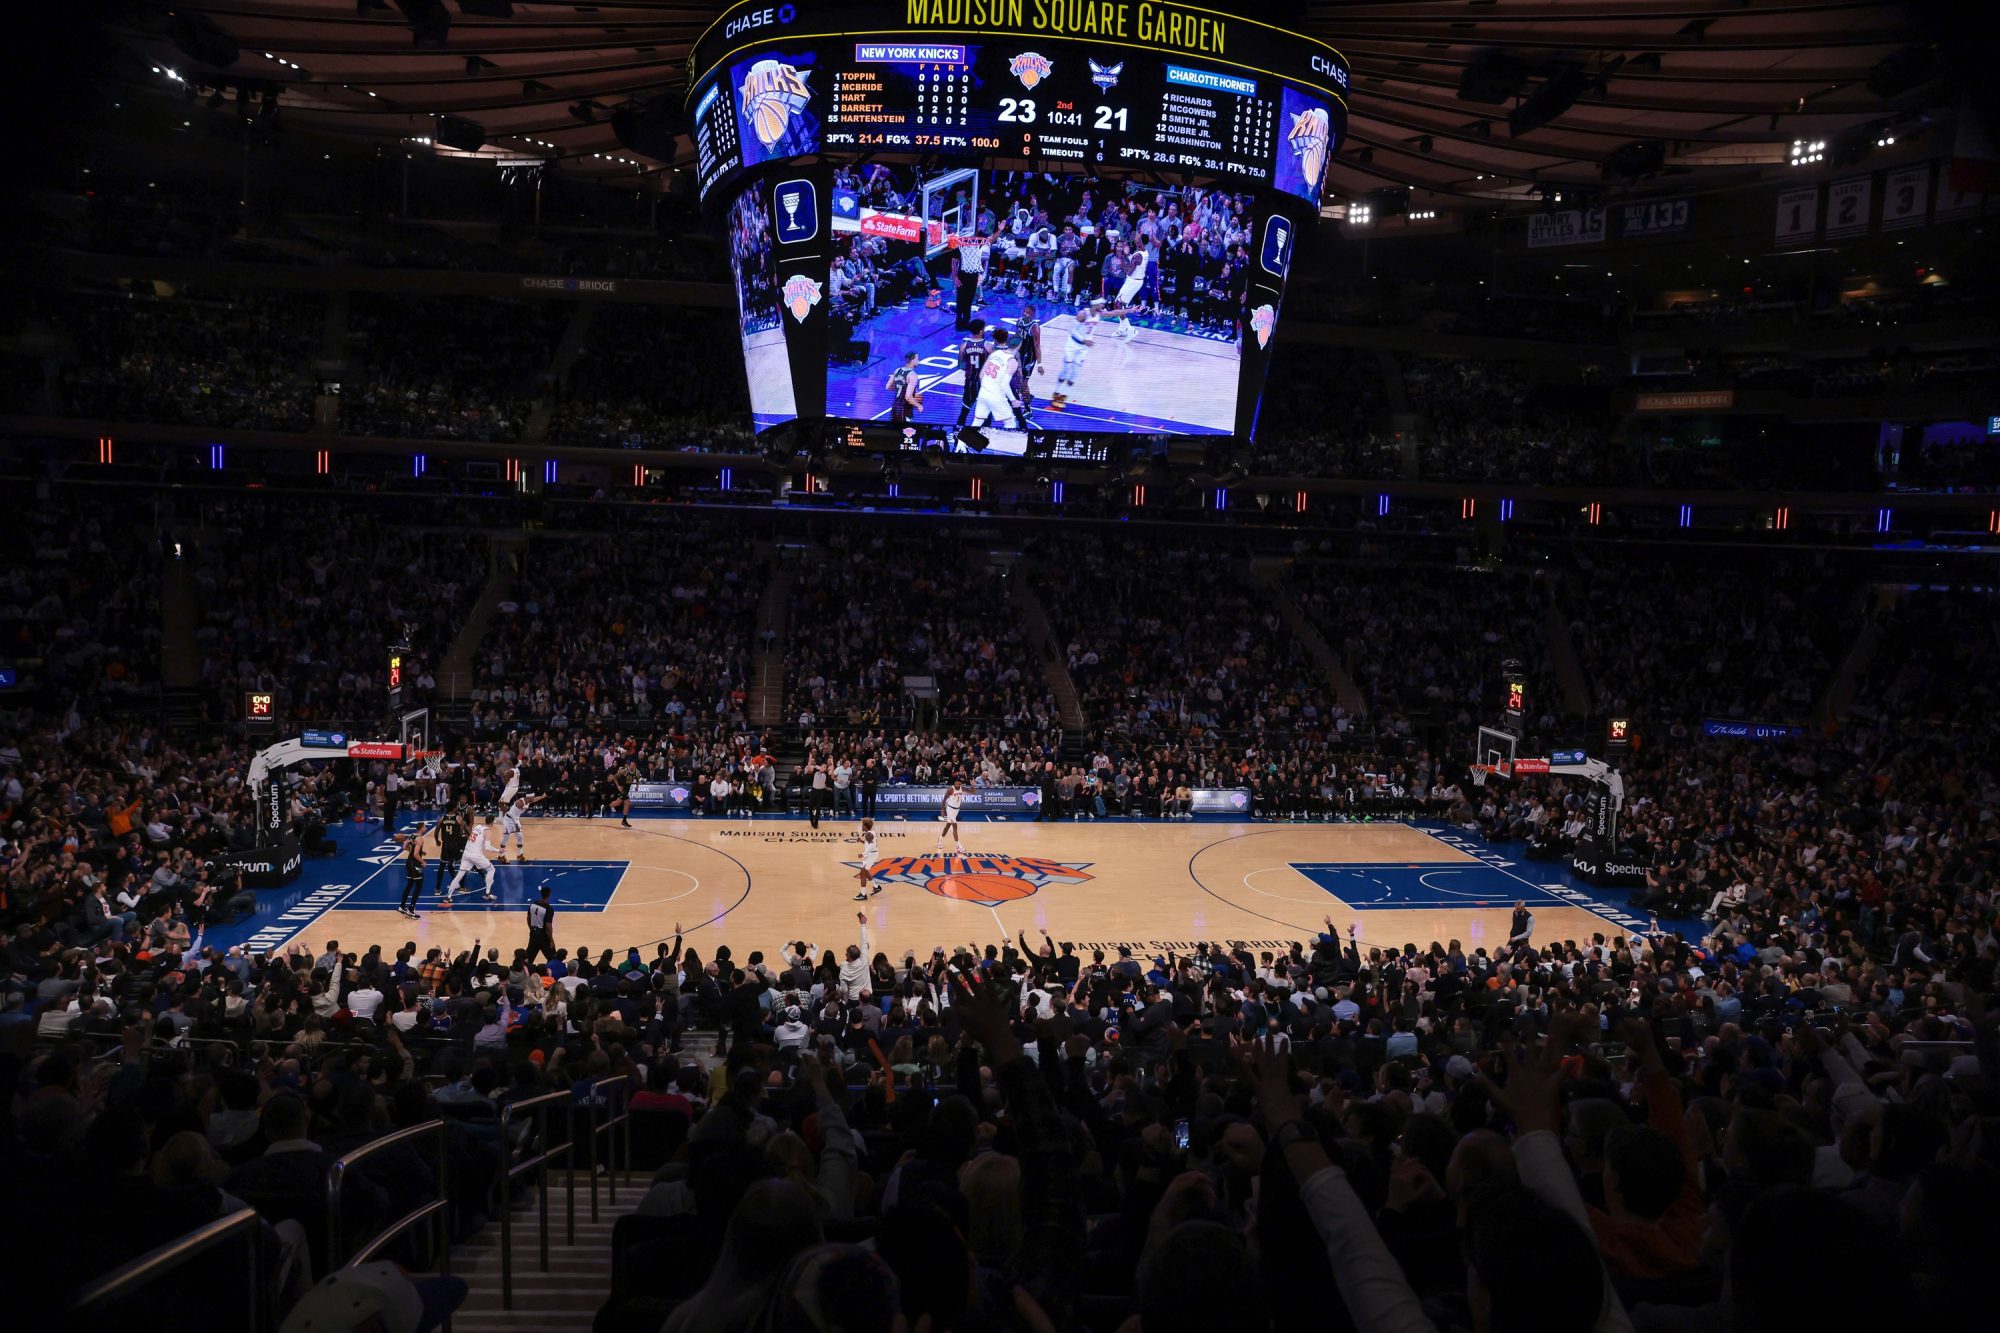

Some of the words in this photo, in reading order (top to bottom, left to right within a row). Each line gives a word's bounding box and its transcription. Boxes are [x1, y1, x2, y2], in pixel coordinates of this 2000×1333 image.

[726, 8, 774, 39] CHASE
[907, 0, 1022, 27] MADISON
[1032, 0, 1128, 38] SQUARE
[1137, 3, 1225, 54] GARDEN
[861, 47, 885, 58] NEW
[887, 48, 916, 58] YORK
[918, 48, 959, 60] KNICKS
[1013, 55, 1049, 73] KNICKS
[1311, 55, 1347, 88] CHASE
[743, 64, 808, 113] KNICKS
[833, 83, 839, 91] 2
[842, 83, 883, 91] MCBRIDE
[1169, 69, 1218, 86] CHARLOTTE
[1219, 78, 1255, 93] HORNETS
[961, 96, 967, 104] 0
[1056, 100, 1073, 110] 2nd
[1170, 94, 1212, 107] RICHARDS
[841, 104, 883, 112] BARRETT
[918, 105, 923, 113] 1
[947, 106, 952, 114] 1
[998, 98, 1036, 123] 23
[1162, 103, 1168, 111] 7
[1169, 104, 1217, 118] MCGOWENS
[840, 115, 905, 123] HARTENSTEIN
[931, 116, 937, 124] 0
[1047, 111, 1082, 126] 10:41
[1094, 105, 1128, 132] 21
[1161, 113, 1167, 121] 8
[1168, 115, 1196, 125] SMITH
[1196, 119, 1210, 127] JR.
[1167, 125, 1196, 136] OUBRE
[1198, 129, 1211, 138] JR.
[827, 134, 854, 143] 3PT%
[859, 134, 883, 143] 21.4
[886, 135, 910, 144] FG%
[915, 135, 940, 145] 37.5
[943, 137, 967, 146] FT%
[971, 138, 999, 147] 100.0
[1024, 133, 1031, 142] 0
[1039, 135, 1060, 144] TEAM
[1062, 136, 1088, 146] FOULS
[1098, 140, 1104, 149] 1
[1155, 133, 1165, 142] 25
[1167, 135, 1222, 150] WASHINGTON
[1263, 150, 1268, 158] 3
[1023, 146, 1030, 155] 6
[1041, 148, 1084, 158] TIMEOUTS
[1096, 152, 1104, 161] 6
[1120, 147, 1150, 160] 3PT%
[1153, 152, 1175, 163] 28.6
[1179, 155, 1201, 167] FG%
[1204, 159, 1224, 170] 38.1
[1227, 162, 1246, 174] FT%
[1248, 166, 1266, 178] 75.0
[1896, 185, 1915, 215] 3
[1650, 200, 1689, 228] 133
[1790, 203, 1801, 232] 1
[1838, 196, 1858, 225] 2
[1535, 213, 1570, 227] HARRY
[1579, 208, 1602, 235] 15
[1532, 224, 1574, 239] STYLES
[523, 278, 565, 288] CHASE
[579, 280, 615, 291] BRIDGE
[970, 355, 980, 369] 4
[985, 362, 1000, 379] 55
[253, 703, 267, 713] 24
[1509, 692, 1521, 708] 24
[1612, 728, 1624, 737] 24
[884, 793, 905, 803] SPORTS
[906, 793, 930, 803] BETTING
[961, 794, 982, 803] KNICKS
[270, 784, 281, 829] Spectrum
[1597, 796, 1607, 835] Spectrum
[445, 825, 453, 835] 4
[1438, 836, 1516, 868] DELTA
[854, 857, 1096, 882] KNICKS
[1605, 862, 1647, 876] Spectru
[276, 884, 352, 921] KNICKS
[1539, 884, 1593, 901] NEW
[1581, 902, 1649, 926] YORK
